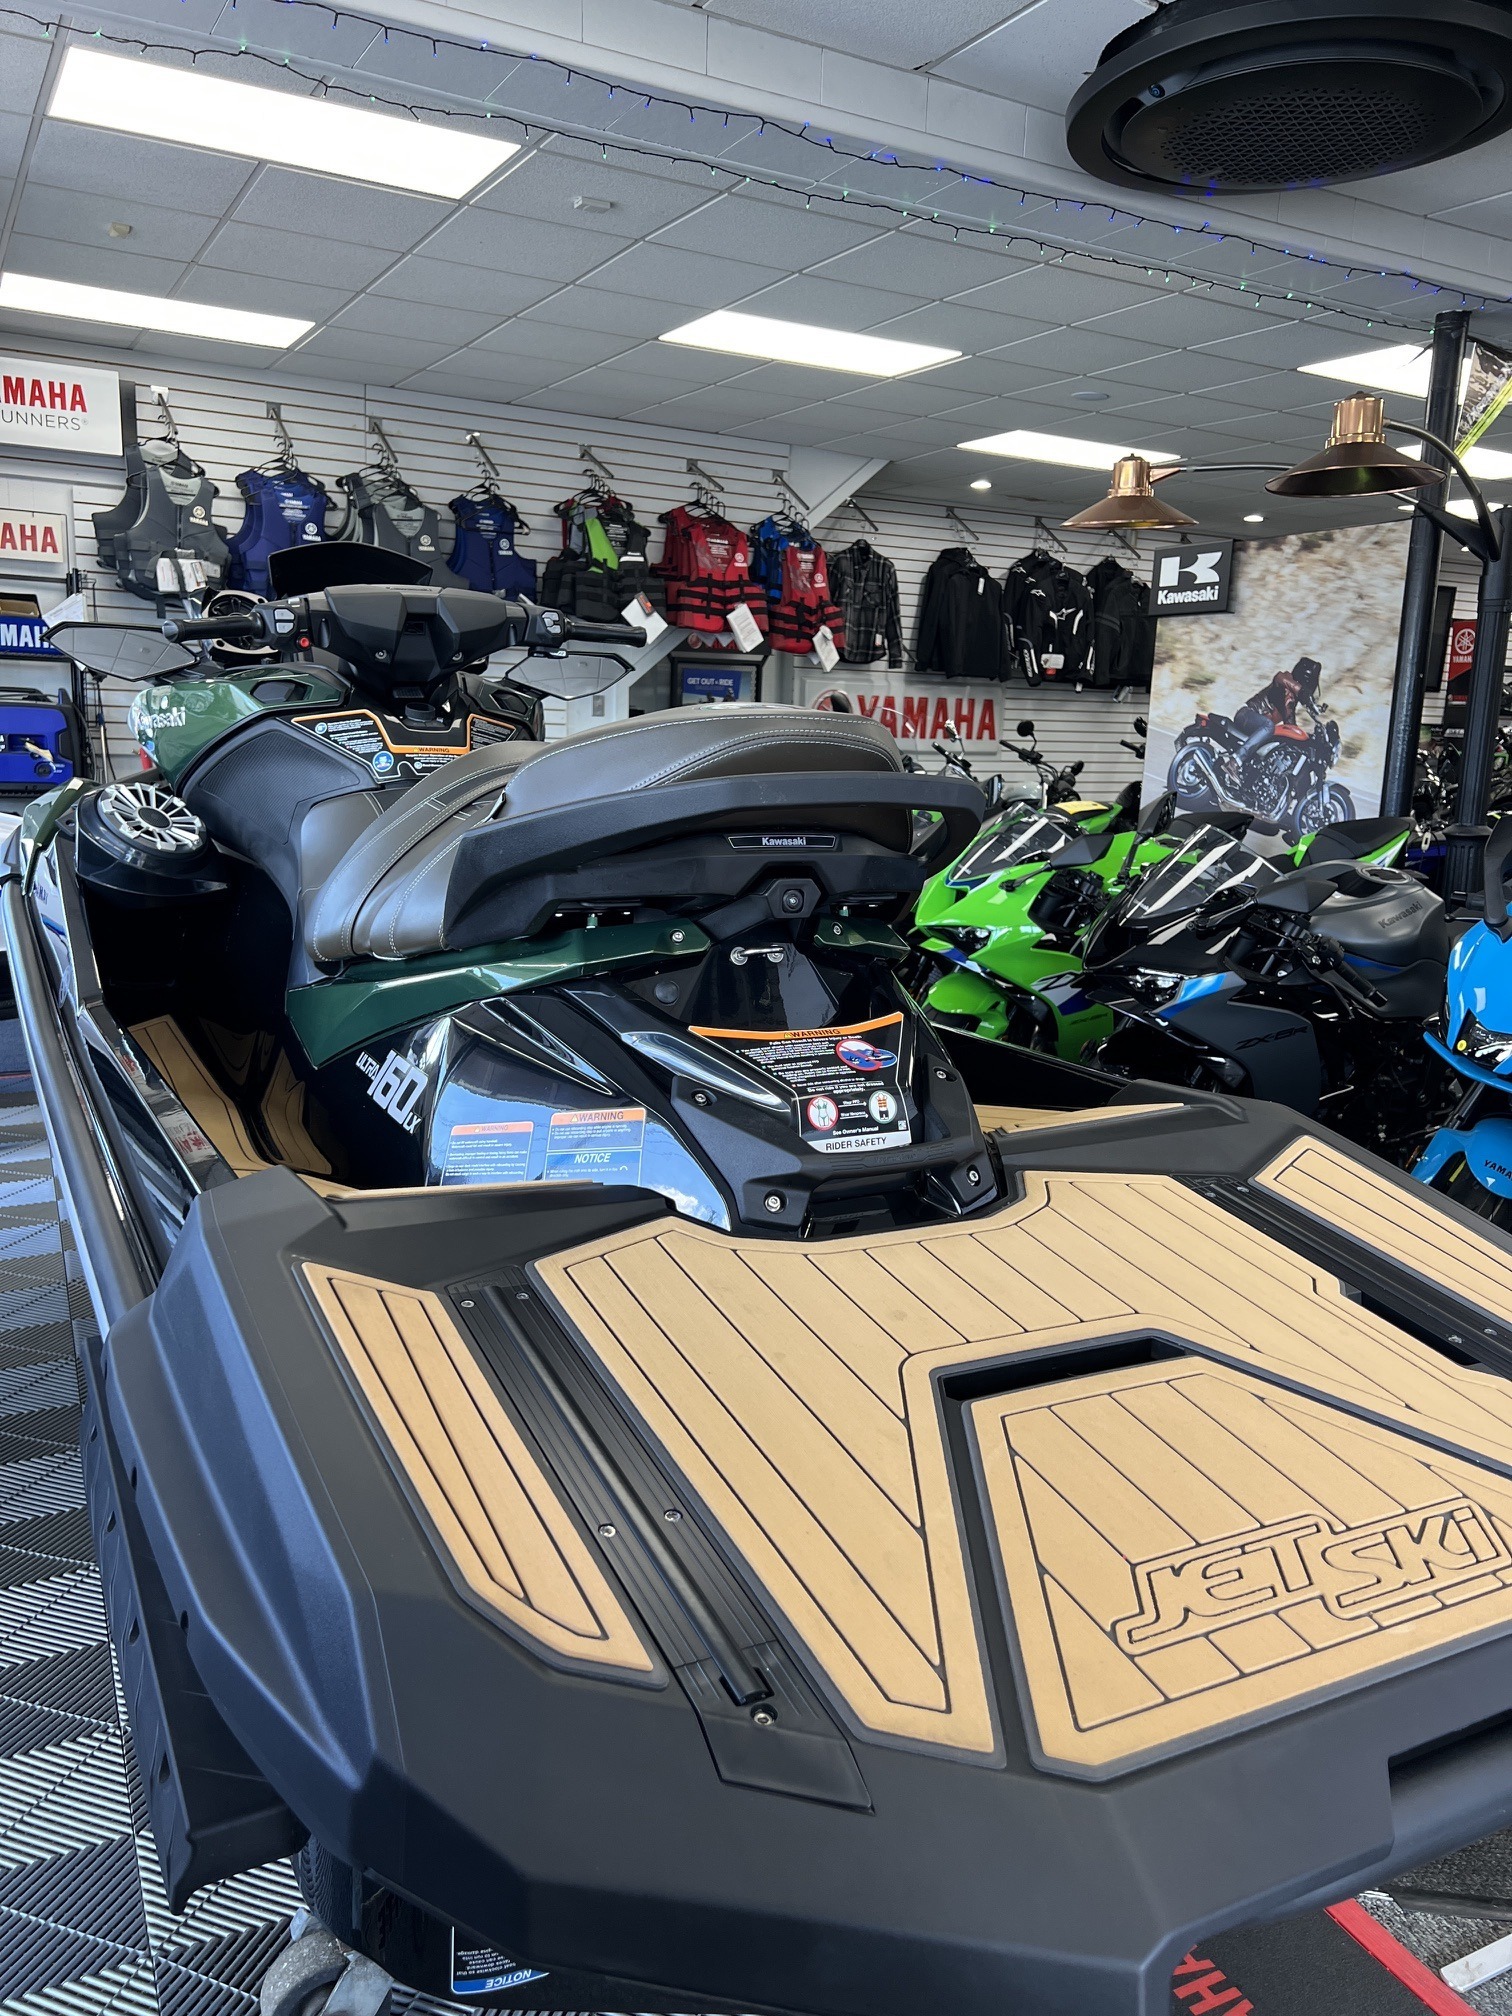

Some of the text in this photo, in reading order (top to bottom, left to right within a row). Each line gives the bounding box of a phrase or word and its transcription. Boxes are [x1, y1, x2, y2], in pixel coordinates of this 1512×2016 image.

[0, 375, 87, 413] MAHA
[1157, 586, 1219, 605] Kawasaki
[0, 623, 54, 649] MAH
[1453, 655, 1473, 663] YAMAH
[700, 677, 715, 685] OUT
[719, 678, 734, 686] RIDE
[857, 694, 996, 741] YAMAHA
[762, 836, 807, 846] Kawasaki
[1378, 901, 1423, 928] Kawasaki
[790, 1029, 841, 1038] WARNING
[355, 1049, 428, 1134] ULTRA 160 LX
[579, 1111, 624, 1122] WARNING
[482, 1124, 509, 1132] WARNING
[825, 1136, 887, 1151] RIDER SAFETY
[574, 1152, 612, 1164] NOTICE
[485, 1969, 532, 1988] NOTICE
